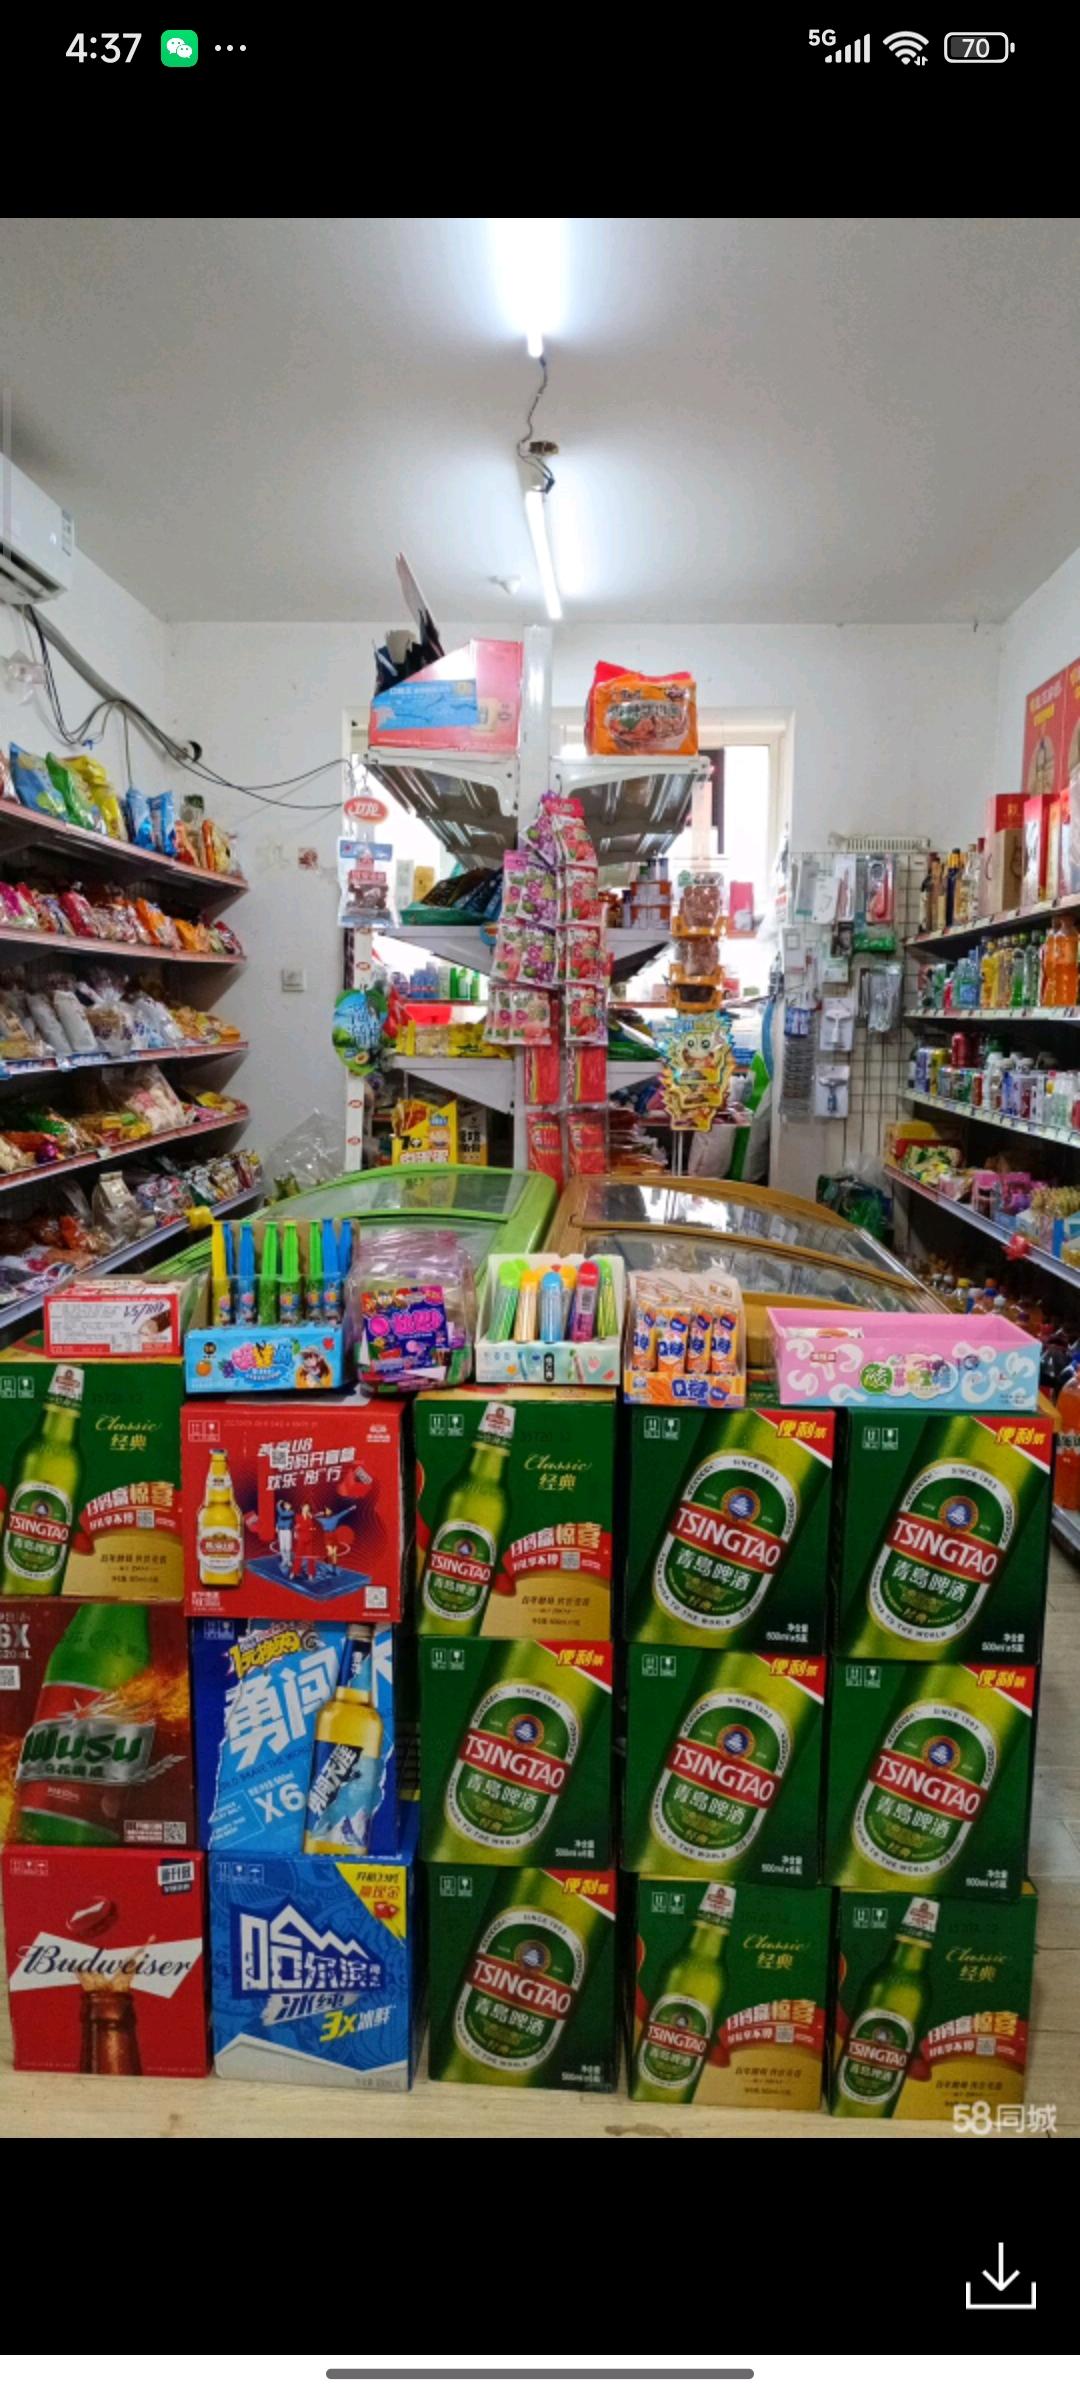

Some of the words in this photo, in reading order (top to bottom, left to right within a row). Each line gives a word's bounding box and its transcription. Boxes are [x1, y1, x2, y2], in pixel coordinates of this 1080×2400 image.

[109, 1435, 146, 1451] 经典
[538, 1474, 576, 1492] 经典
[10, 1515, 68, 1542] TSINGTAO
[676, 1507, 781, 1567] TSINGTAO
[894, 1519, 998, 1576] TSINGTAO
[431, 1554, 490, 1580] TSINGTAO
[676, 1548, 751, 1591] 青岛啤酒
[892, 1559, 968, 1602] 青岛啤酒
[467, 1734, 565, 1789] TSINGTAO
[673, 1744, 774, 1801] TSINGTAO
[255, 1781, 306, 1824] X6
[466, 1773, 539, 1813] 青岛啤酒
[673, 1784, 747, 1825] 青岛啤酒
[876, 1755, 980, 1815] TSINGTAO
[876, 1795, 952, 1839] 青岛啤酒
[17, 1945, 193, 1977] Budweiser
[756, 1952, 795, 1971] 经典
[959, 1965, 996, 1982] 经典
[473, 1959, 571, 2013] TSINGTAO
[474, 1996, 546, 2036] 青岛啤酒
[648, 2025, 706, 2053] TSINGTAO
[850, 2042, 907, 2067] TSINGTAO
